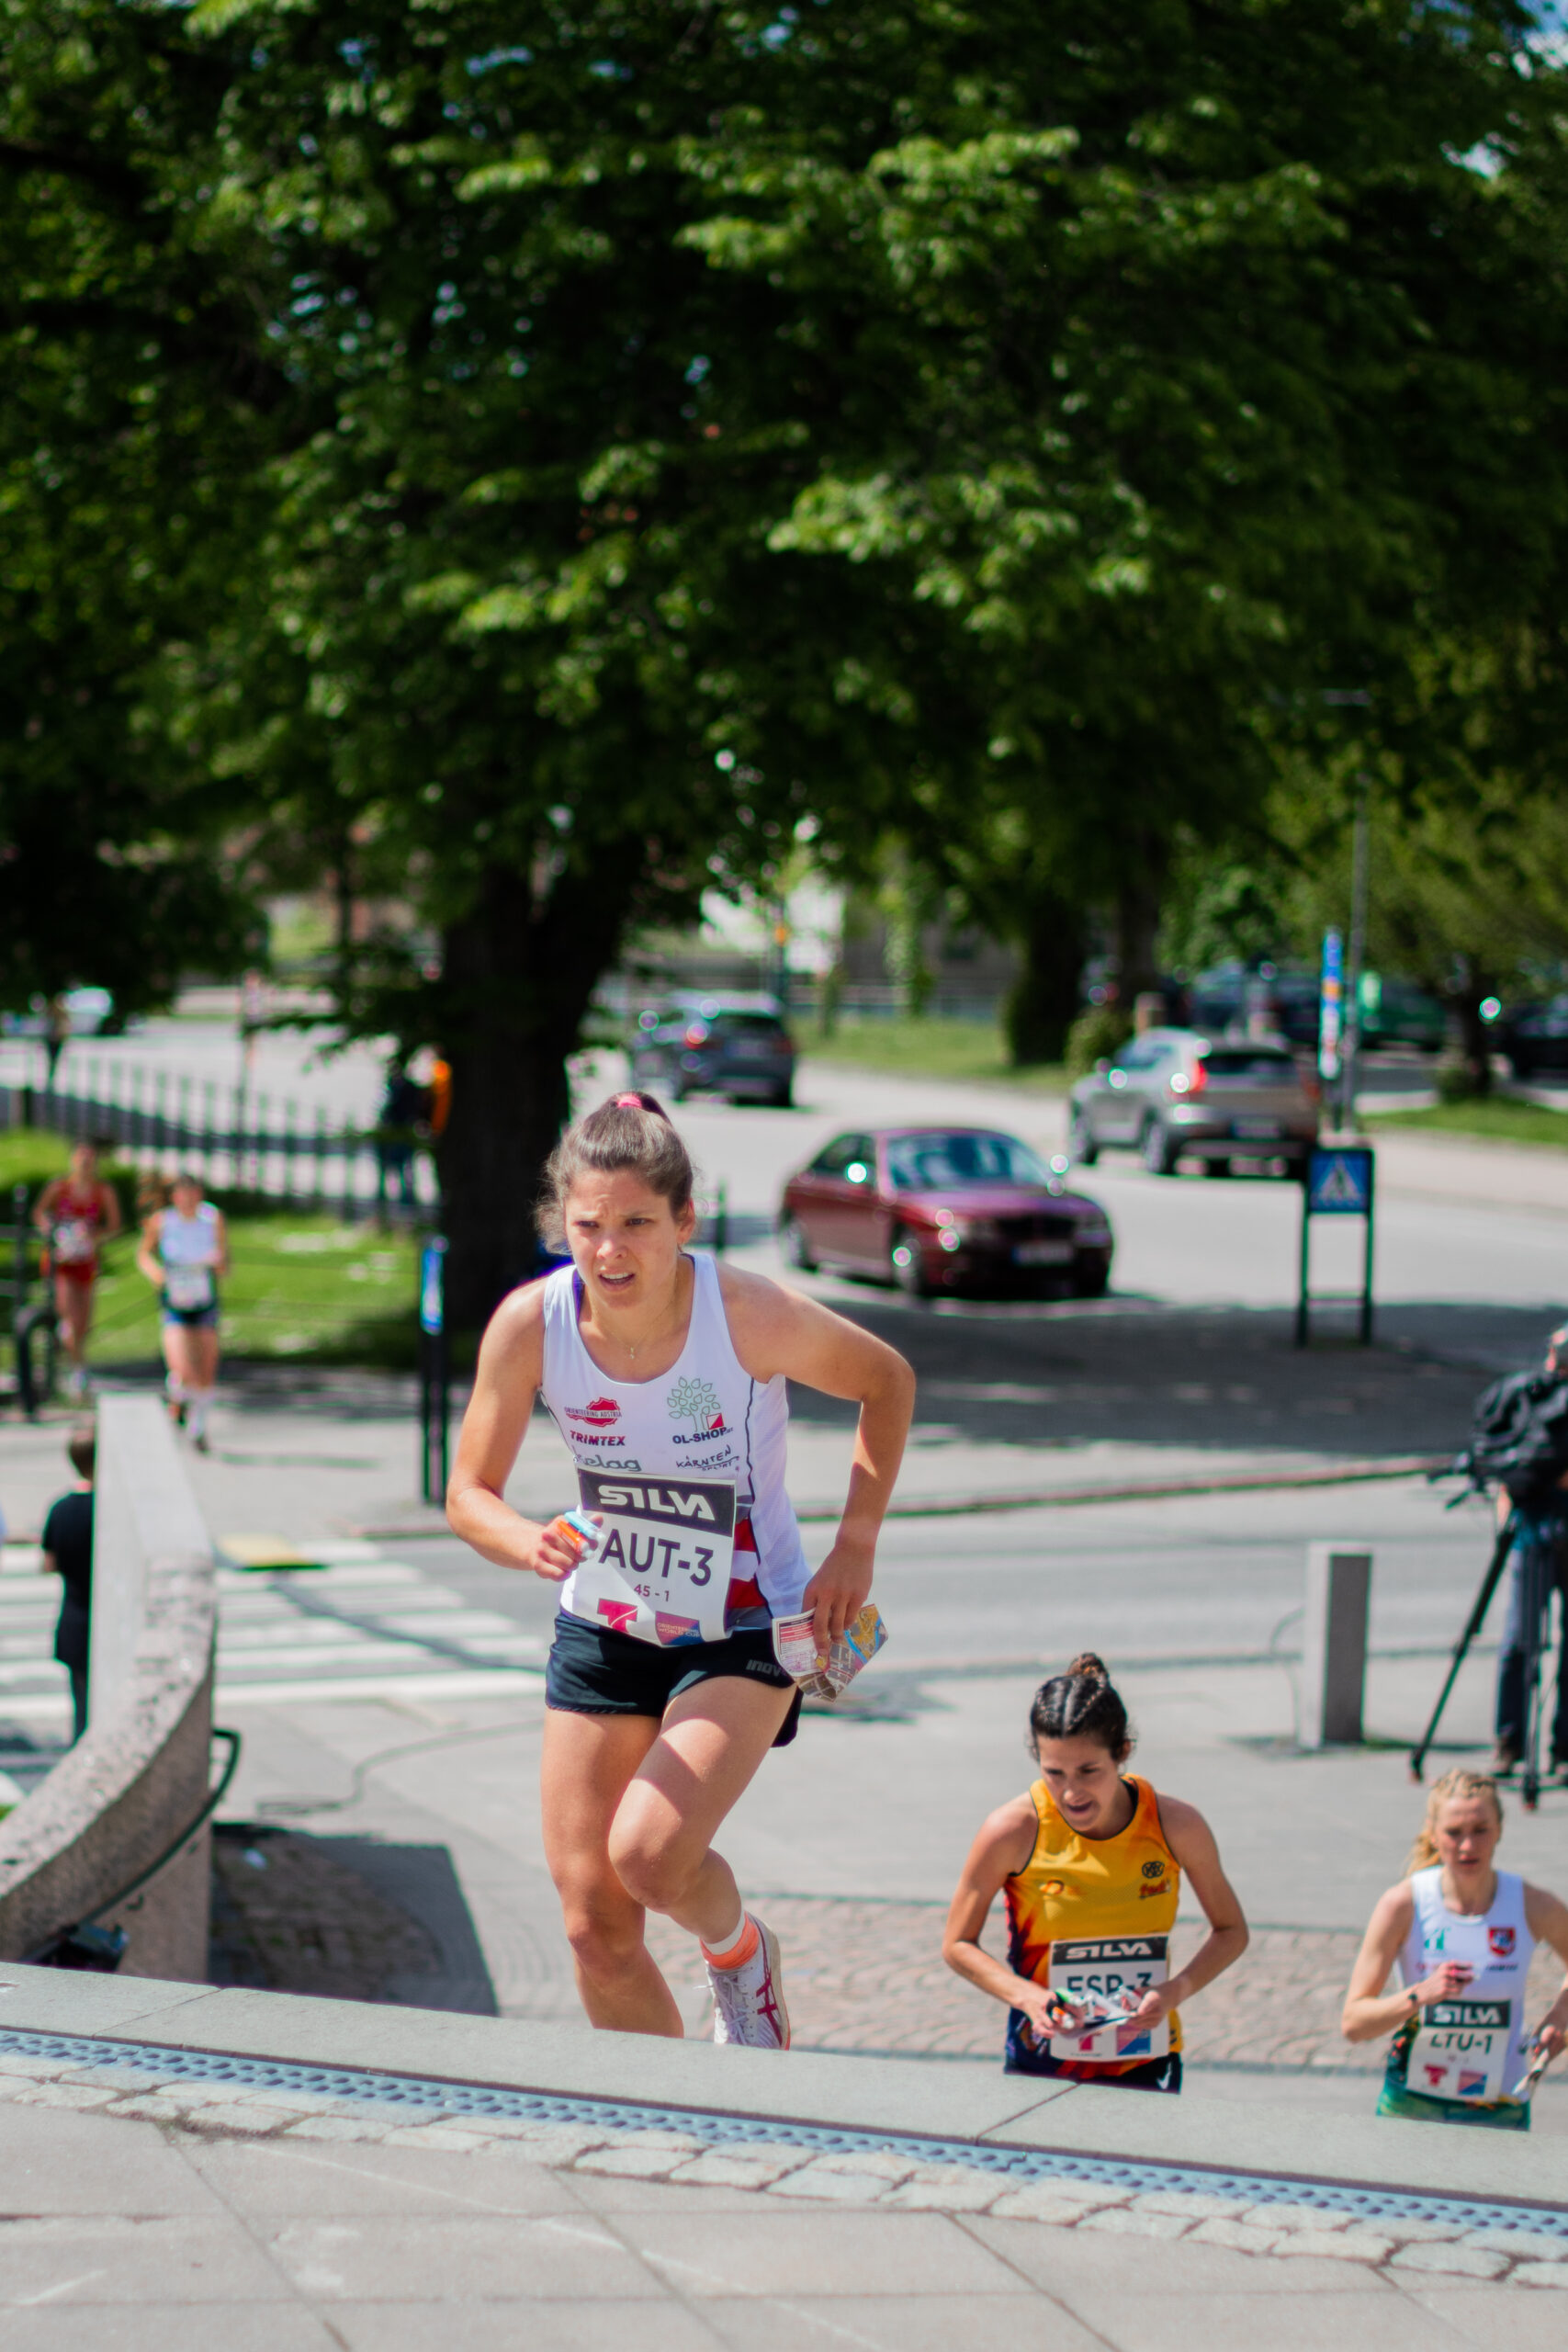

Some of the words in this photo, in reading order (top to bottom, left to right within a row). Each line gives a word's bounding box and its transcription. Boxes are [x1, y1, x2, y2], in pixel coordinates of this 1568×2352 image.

[570, 1430, 626, 1447] TRIMTEX
[599, 1485, 715, 1521] SILVA
[598, 1529, 714, 1587] AUT-3
[634, 1584, 651, 1597] 45
[1066, 1942, 1152, 1959] SILVA
[1434, 2005, 1501, 2024] SILVA
[1430, 2033, 1493, 2054] LTU-1
